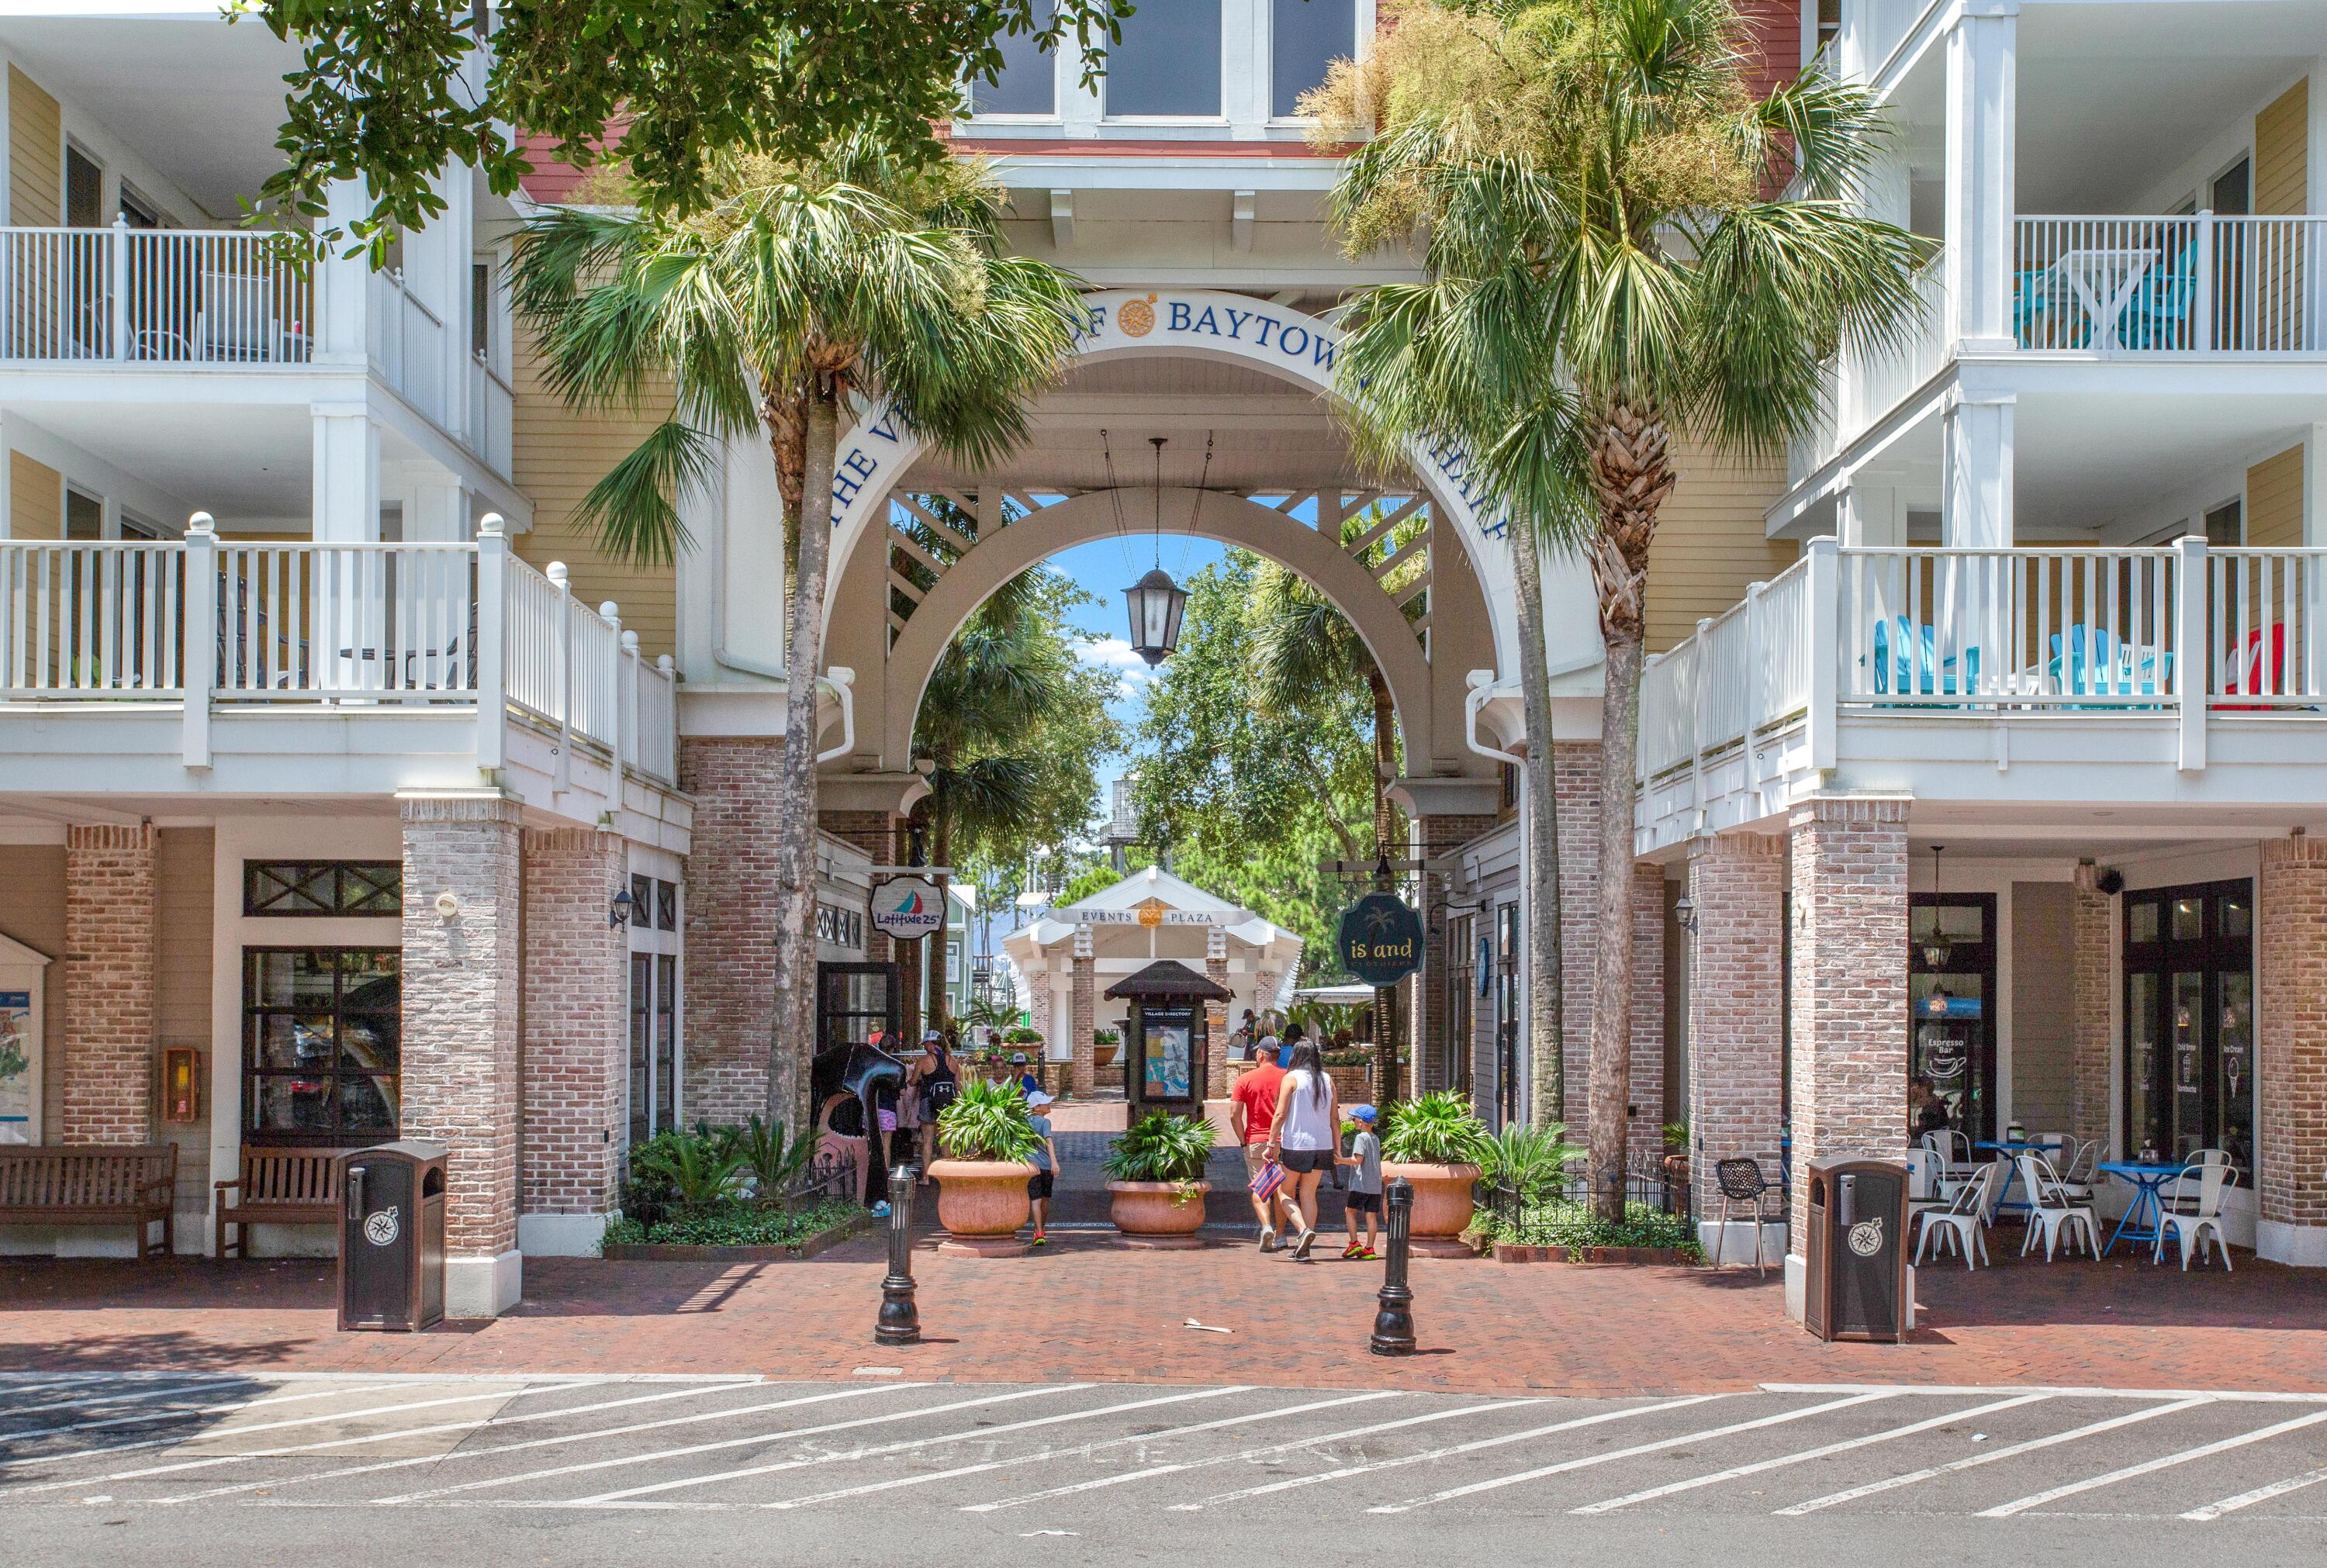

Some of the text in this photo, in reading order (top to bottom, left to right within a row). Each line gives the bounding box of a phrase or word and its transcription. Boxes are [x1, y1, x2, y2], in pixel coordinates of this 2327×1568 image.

[1167, 302, 1350, 375] BAYTOW
[877, 913, 921, 926] Latitude
[1082, 912, 1212, 922] EVENTS PLAZA
[1928, 1039, 1964, 1048] Espresso
